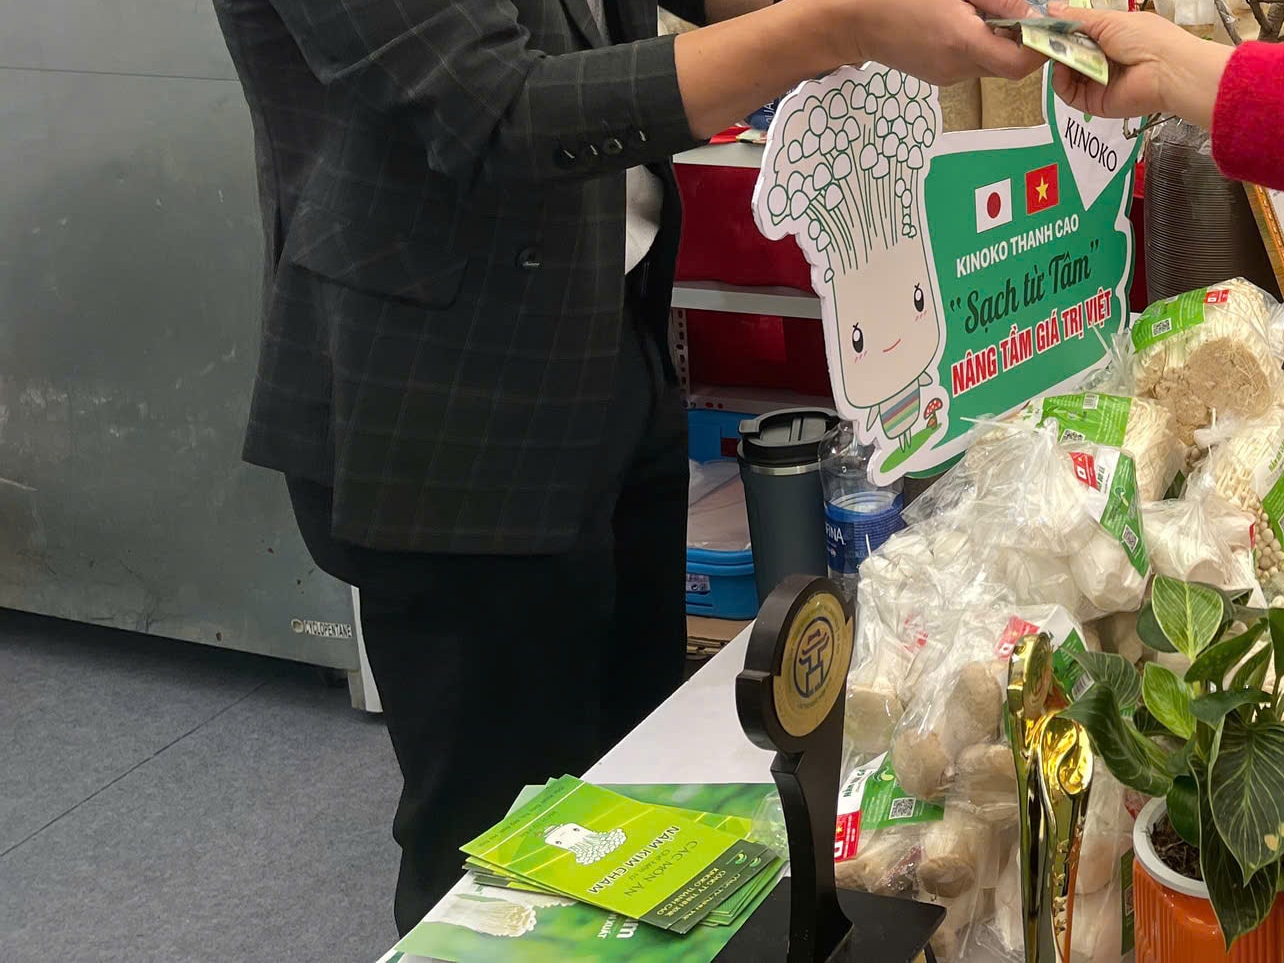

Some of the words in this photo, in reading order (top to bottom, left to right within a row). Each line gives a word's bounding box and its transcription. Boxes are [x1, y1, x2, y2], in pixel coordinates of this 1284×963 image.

[1063, 116, 1119, 173] KINOKO
[955, 238, 1009, 278] KINOKO
[1009, 227, 1055, 255] THANH
[1055, 213, 1079, 238] CAO
[1022, 264, 1045, 310] từ
[951, 349, 999, 397] NÂNG
[999, 322, 1033, 372] TẦM
[1035, 316, 1060, 354] GIÁ
[1061, 308, 1084, 340] TRỊ
[1085, 287, 1114, 329] VIỆT
[624, 849, 652, 867] KIM
[671, 887, 695, 904] THANH
[697, 885, 708, 894] TY
[656, 903, 673, 916] CAO
